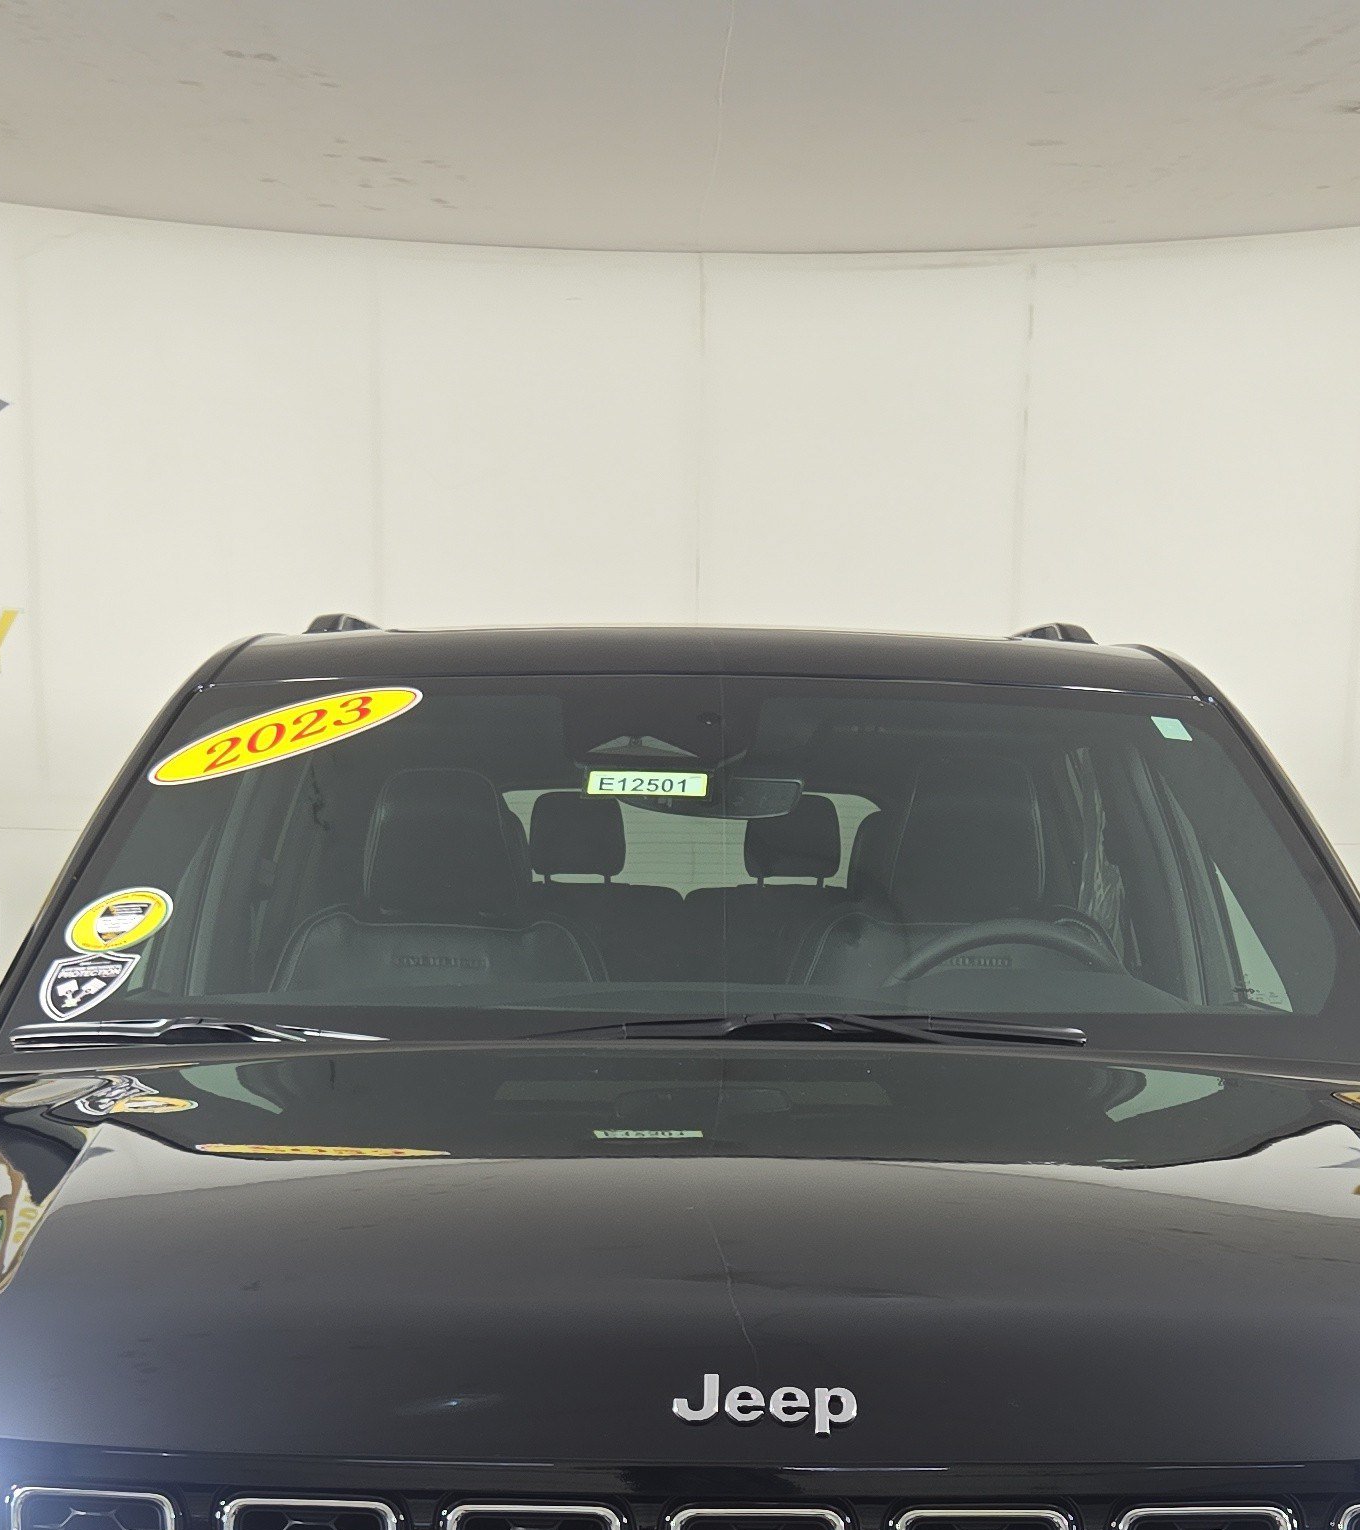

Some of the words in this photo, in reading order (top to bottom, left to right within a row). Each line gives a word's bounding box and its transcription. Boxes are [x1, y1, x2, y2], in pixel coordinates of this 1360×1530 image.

[203, 696, 373, 773] 2023
[598, 777, 687, 793] E12501
[671, 1373, 858, 1438] Jeep
